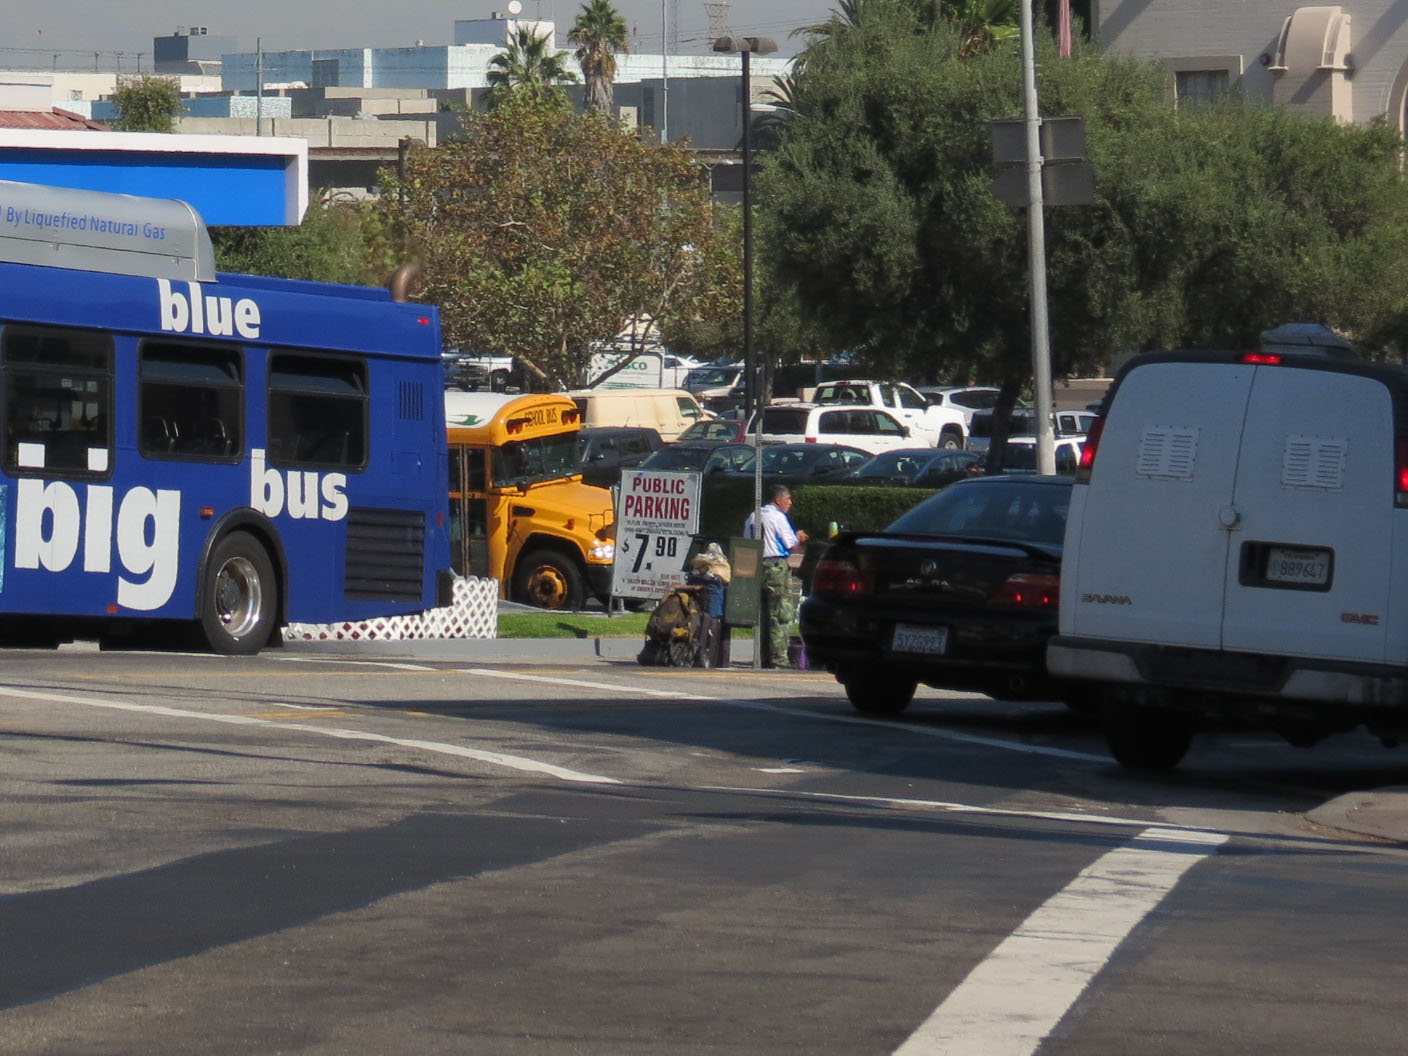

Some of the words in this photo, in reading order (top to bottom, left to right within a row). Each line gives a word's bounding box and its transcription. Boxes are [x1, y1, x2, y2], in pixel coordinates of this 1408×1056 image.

[6, 206, 23, 227] By
[24, 209, 88, 231] Liquefied
[91, 216, 139, 237] Natural
[142, 222, 167, 240] Gas
[157, 278, 262, 339] blue
[546, 407, 558, 424] BUS
[250, 448, 349, 522] bus
[633, 477, 685, 494] PUBLIC
[624, 494, 691, 521] PARKING
[14, 442, 182, 611] big
